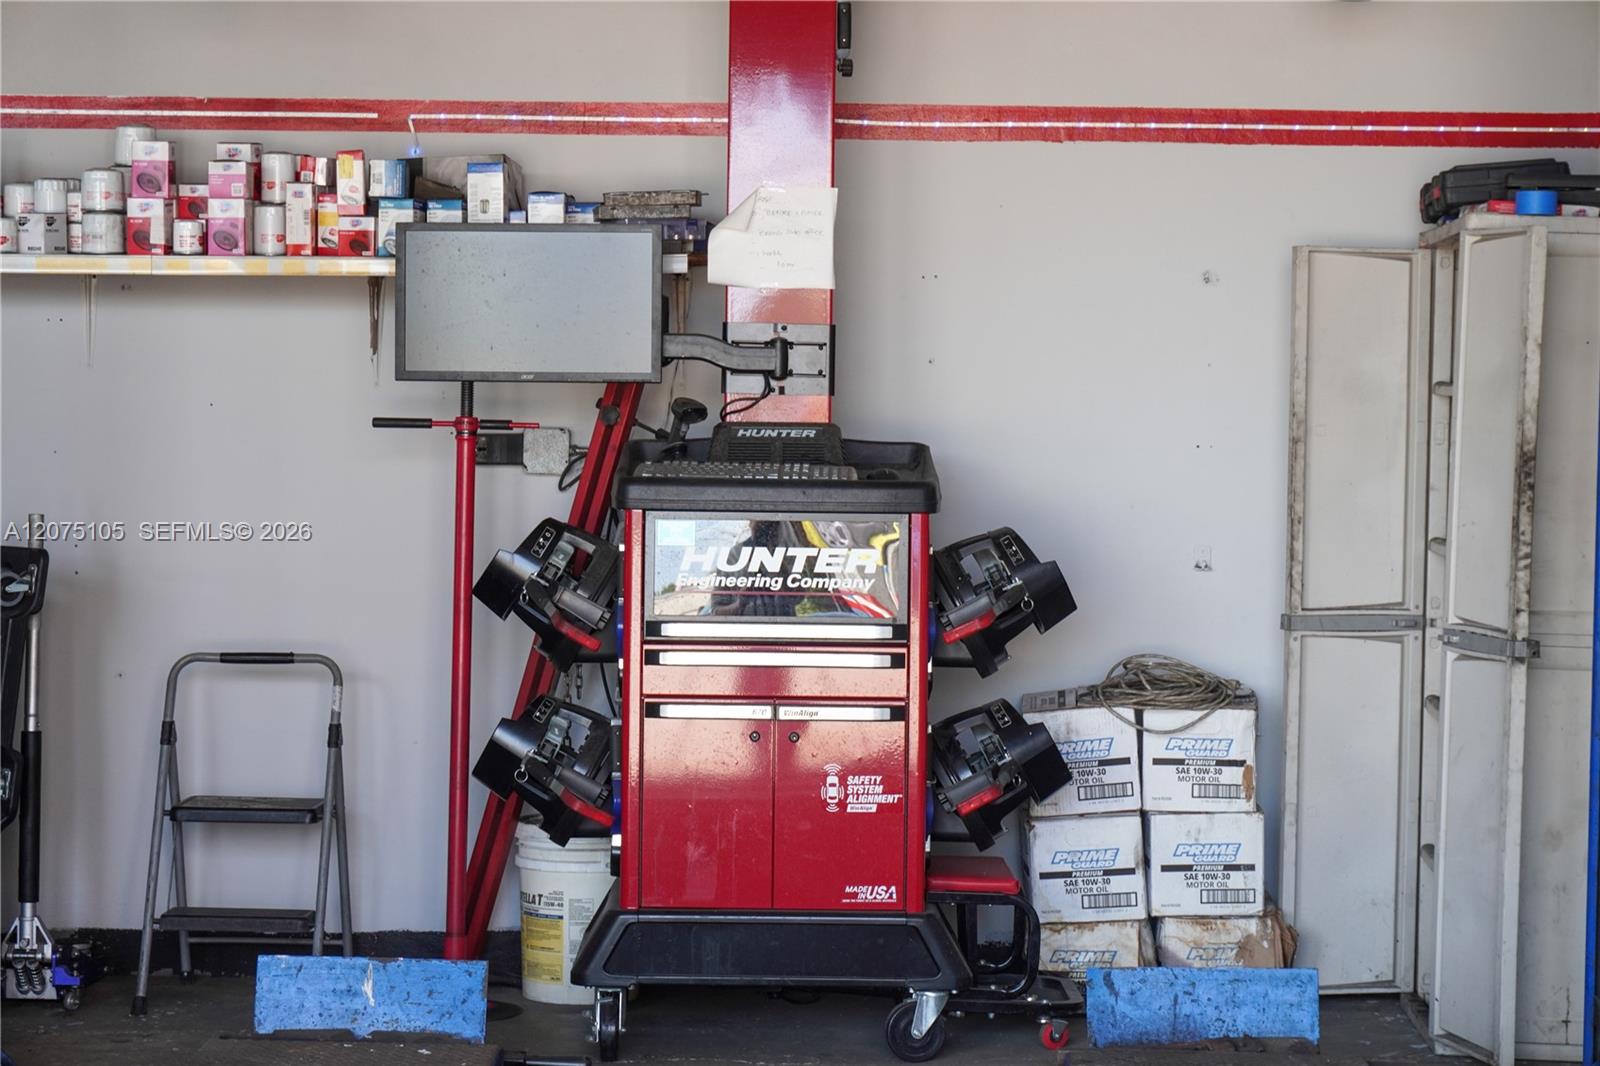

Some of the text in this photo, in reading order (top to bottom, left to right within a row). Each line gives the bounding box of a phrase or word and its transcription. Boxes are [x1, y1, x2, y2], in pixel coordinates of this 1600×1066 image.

[737, 429, 817, 438] HUNTER
[680, 546, 881, 574] HUNTER
[677, 573, 876, 591] Engineering Company
[1165, 738, 1233, 751] PRIME
[1068, 750, 1109, 759] GUARD
[1185, 749, 1229, 758] GUARD
[1068, 760, 1099, 769] PREMIUM
[1076, 768, 1107, 777] 10W-30
[1175, 767, 1223, 776] SAE 10W-30
[846, 775, 883, 785] SAFETY
[1091, 777, 1105, 785] OIL
[1177, 775, 1206, 783] MOTOR
[846, 785, 884, 794] SYSTEM
[846, 794, 899, 804] ALIGNMENT
[1173, 843, 1242, 857] PRIME
[1051, 848, 1119, 865] PRIME
[1193, 855, 1238, 863] GUARD
[1071, 860, 1116, 869] GUARD
[1071, 869, 1104, 878] PREMIUM
[1183, 873, 1231, 881] SAE 10W-30
[1063, 878, 1111, 887] SAE 10W-30
[1186, 881, 1215, 889] MOTOR
[867, 886, 897, 899] USA
[1065, 886, 1109, 895] MOTOR OIL
[1049, 950, 1118, 963] PRIME
